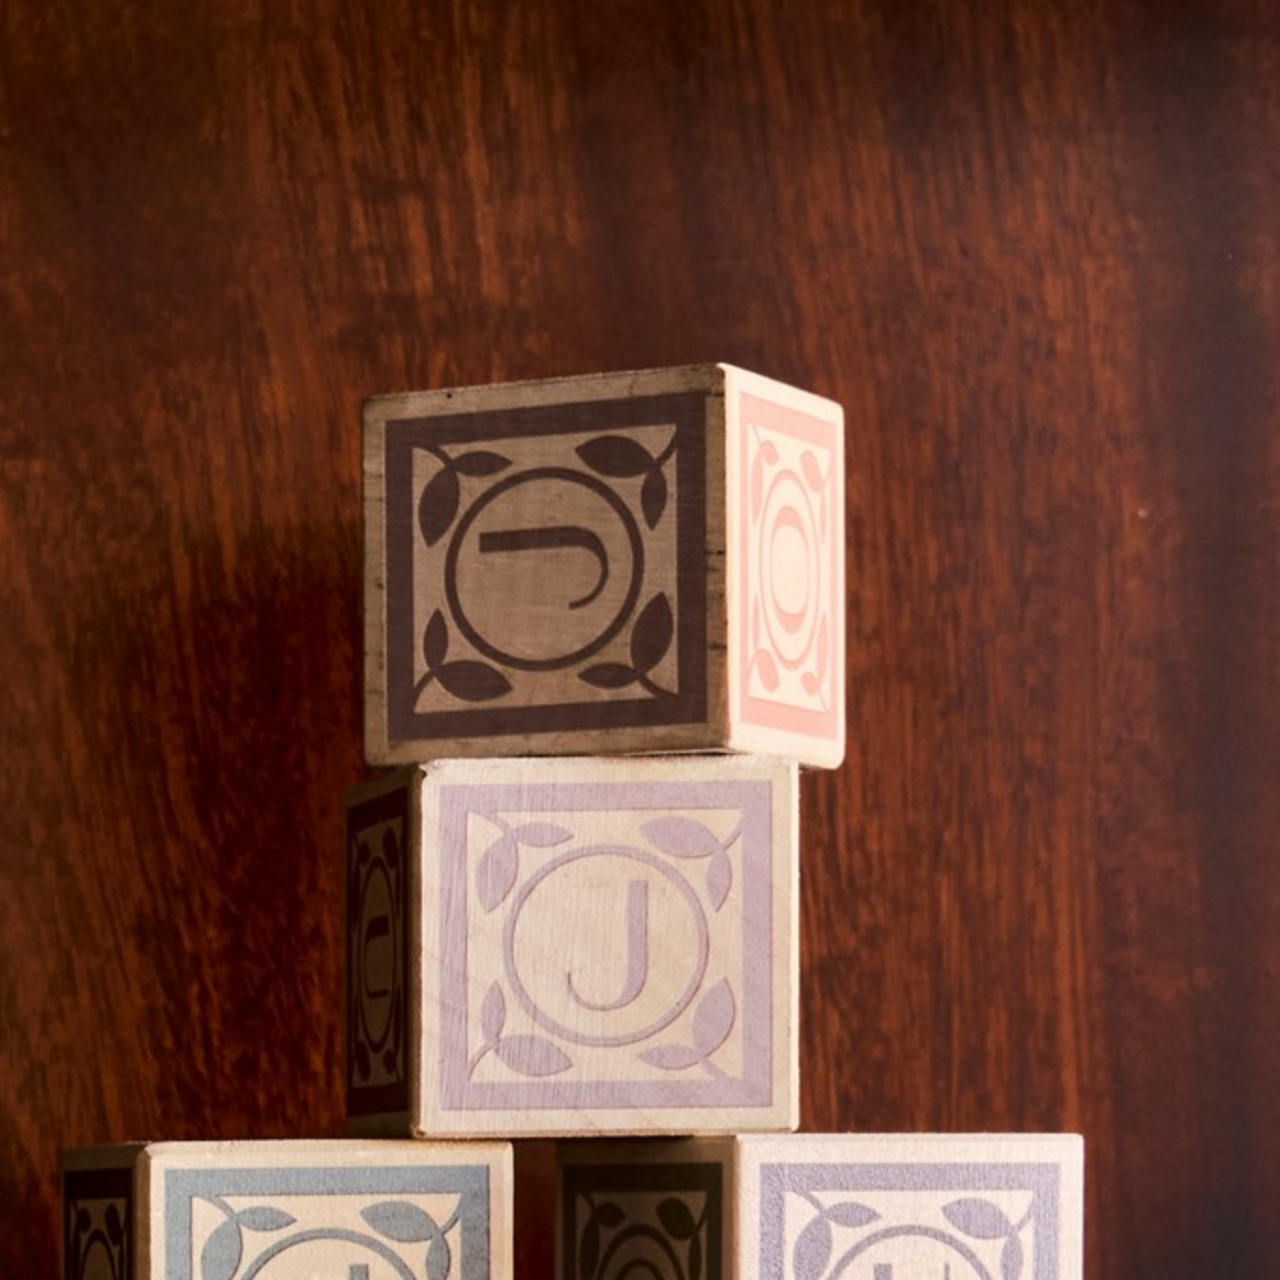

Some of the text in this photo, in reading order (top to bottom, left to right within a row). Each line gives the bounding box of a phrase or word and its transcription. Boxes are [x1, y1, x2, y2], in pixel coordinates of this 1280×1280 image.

[478, 526, 609, 609] J
[770, 505, 811, 634] O
[567, 879, 649, 1012] J
